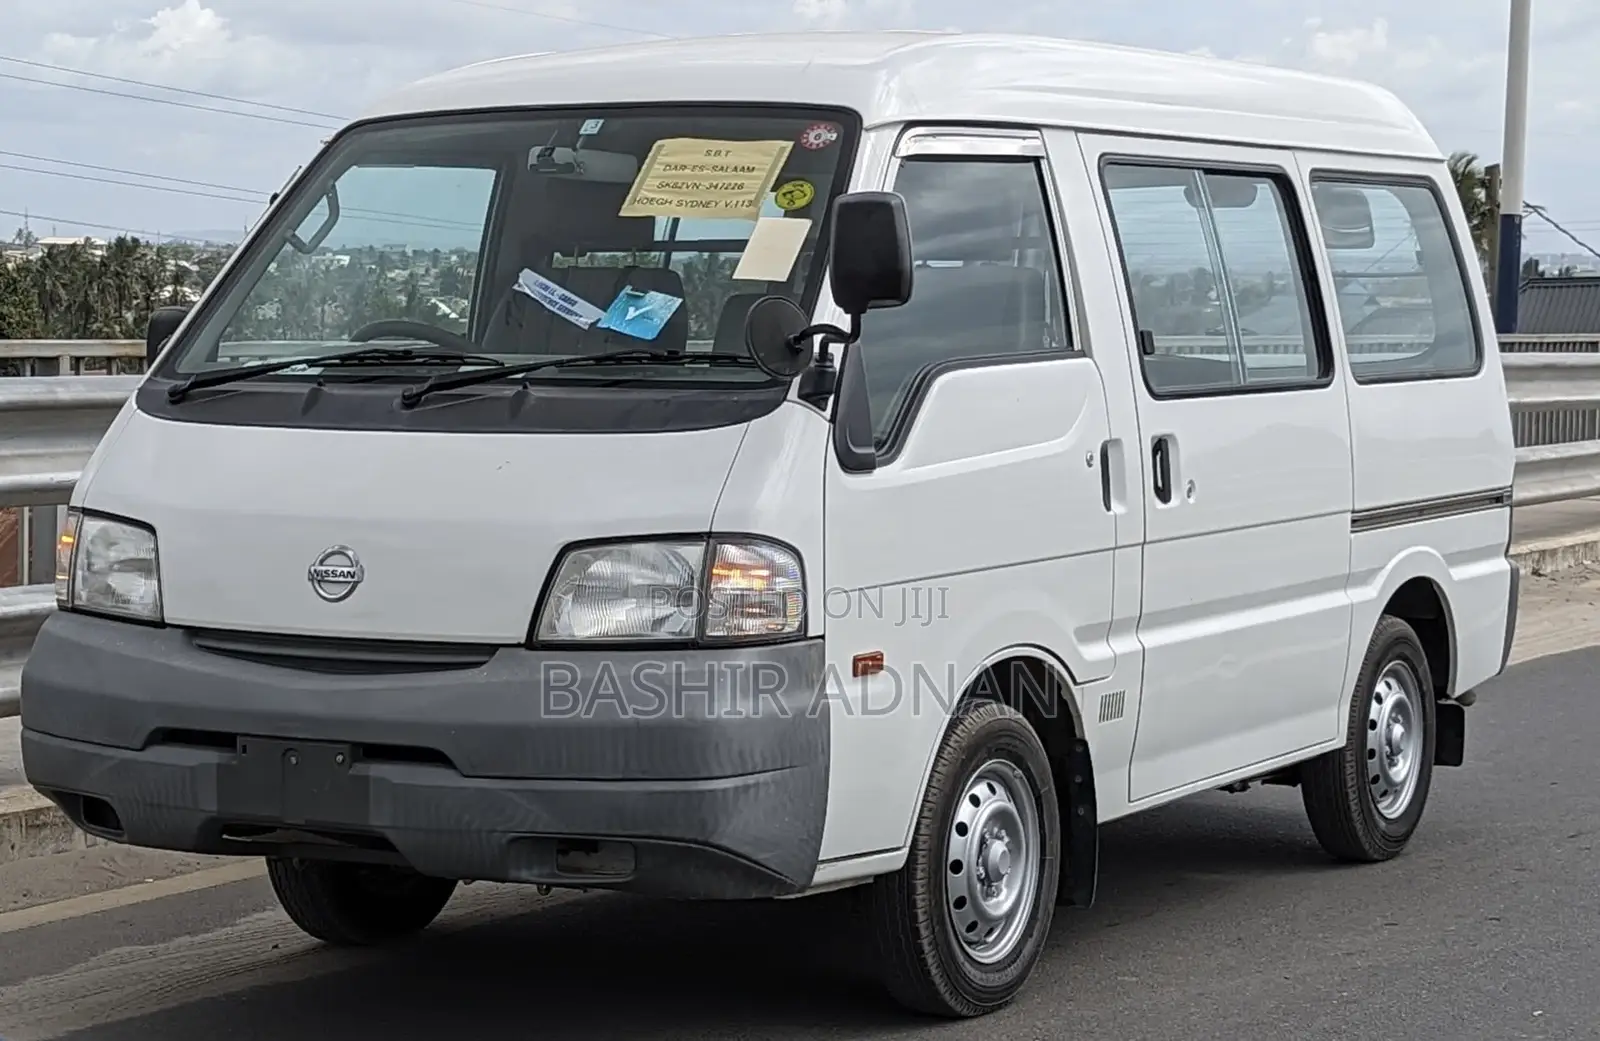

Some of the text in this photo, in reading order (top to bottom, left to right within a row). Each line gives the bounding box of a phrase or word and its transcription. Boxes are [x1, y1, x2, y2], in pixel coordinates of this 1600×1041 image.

[662, 164, 756, 173] DAR-ES-SALAAM
[633, 197, 673, 206] HOEGH
[675, 199, 720, 209] SYDNEY
[313, 568, 356, 579] NISSAN
